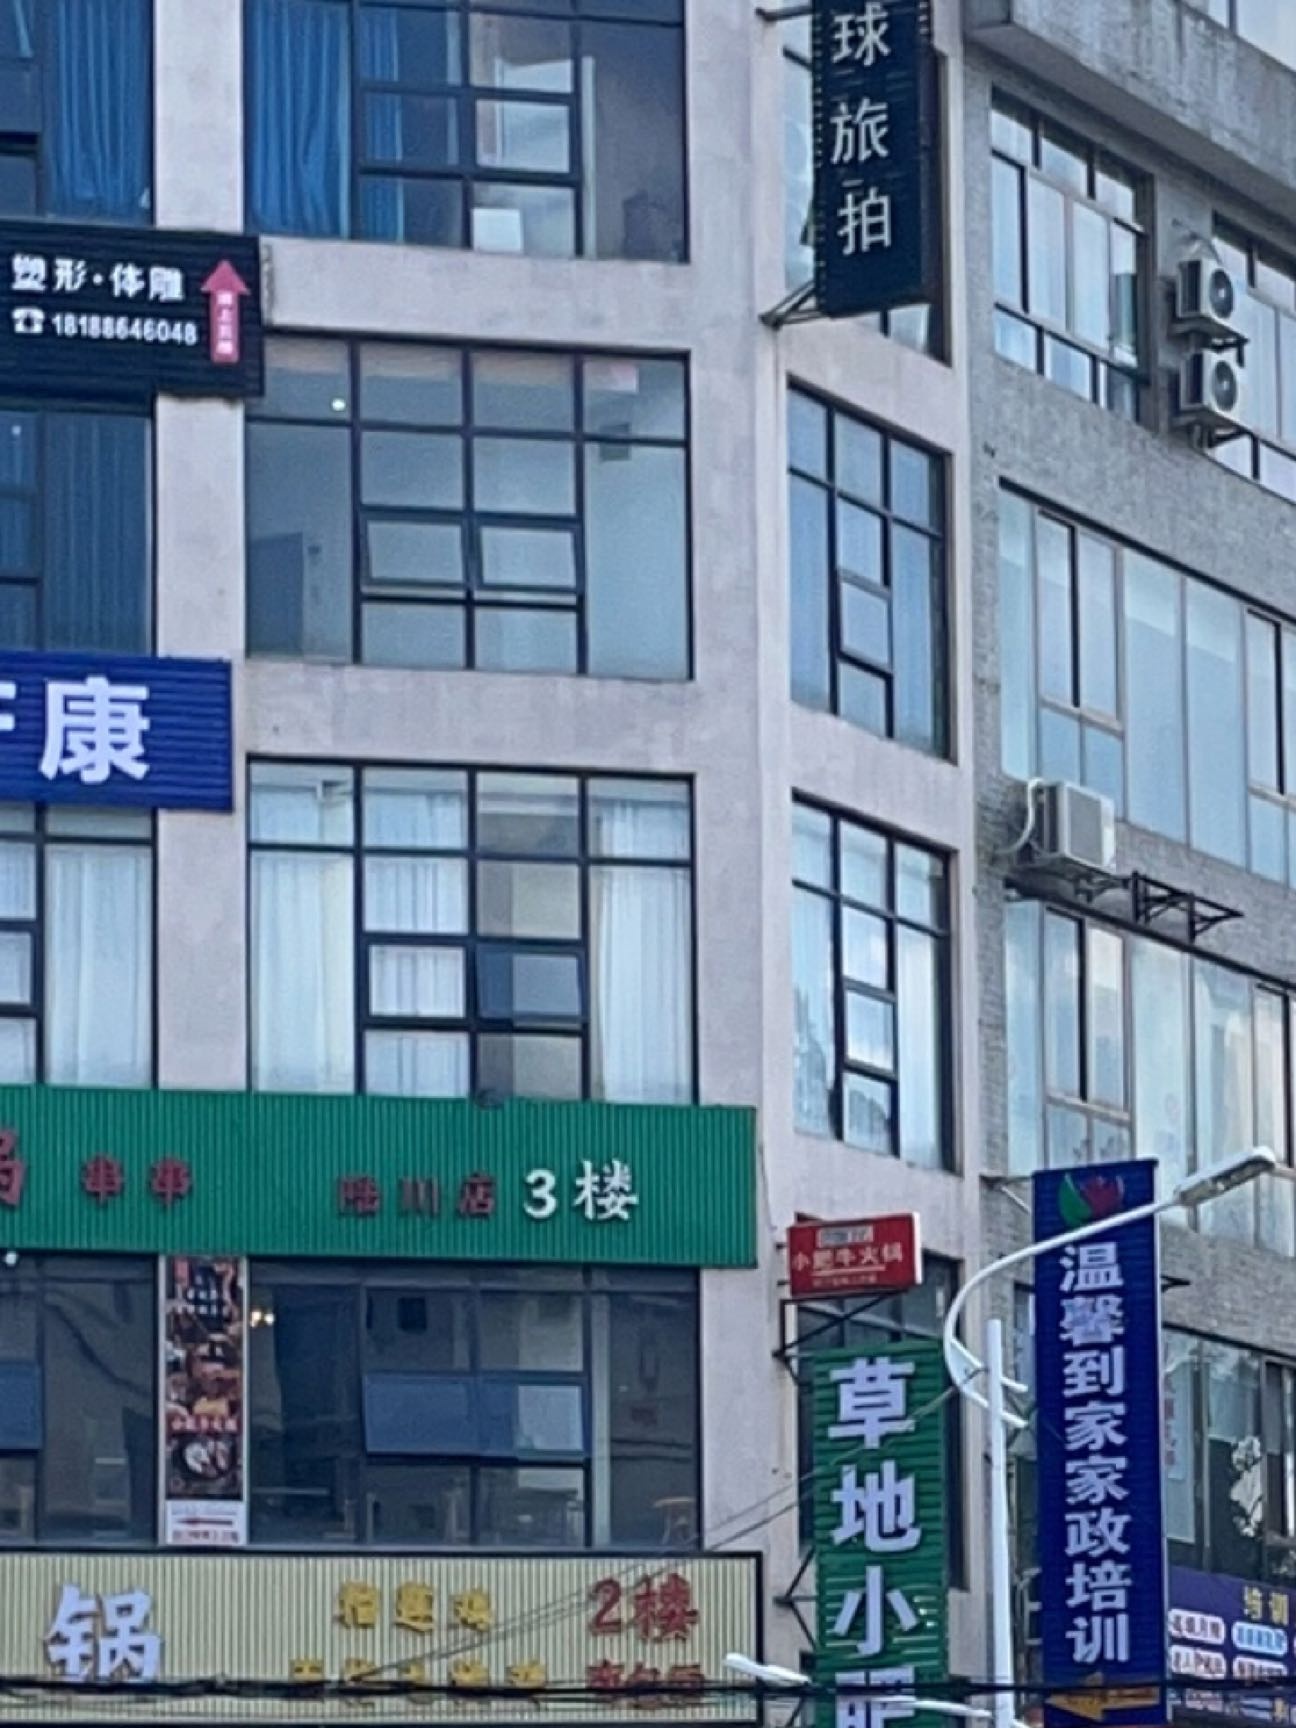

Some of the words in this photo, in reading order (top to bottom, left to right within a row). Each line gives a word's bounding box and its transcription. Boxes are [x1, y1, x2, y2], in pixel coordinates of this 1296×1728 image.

[829, 1, 892, 256] 球旅拍
[0, 675, 151, 784] 康
[523, 1158, 639, 1222] 3楼
[1058, 1241, 1133, 1663] 温馨到家家政培训
[45, 1582, 164, 1684] 锅
[589, 1573, 700, 1642] 2楼
